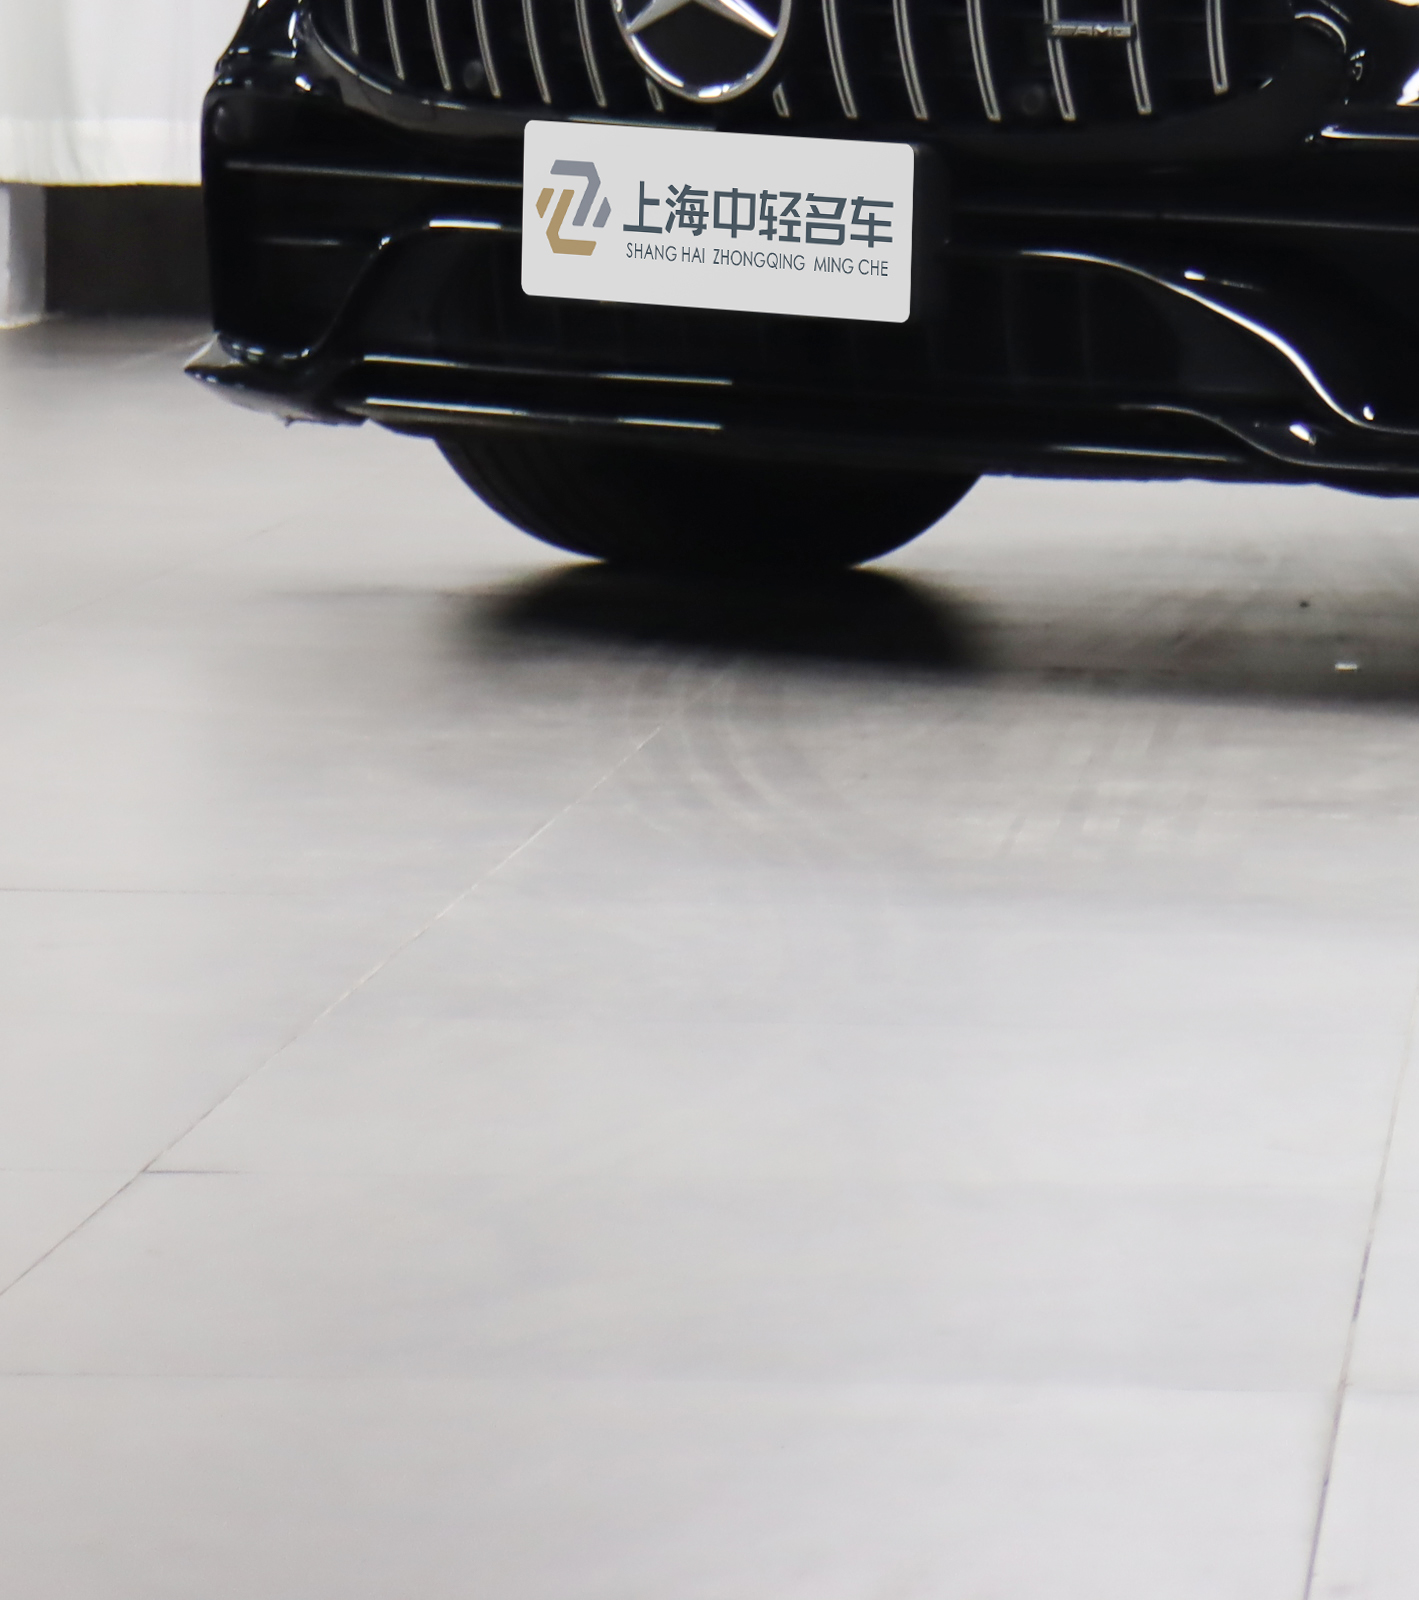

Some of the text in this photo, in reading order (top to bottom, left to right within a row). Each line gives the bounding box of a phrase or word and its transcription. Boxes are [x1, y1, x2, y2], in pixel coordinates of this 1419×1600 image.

[1072, 23, 1131, 38] AMG
[622, 180, 894, 249] 上海中轻名车
[625, 242, 889, 277] SHANG HAI ZHONGQING MING CHE
